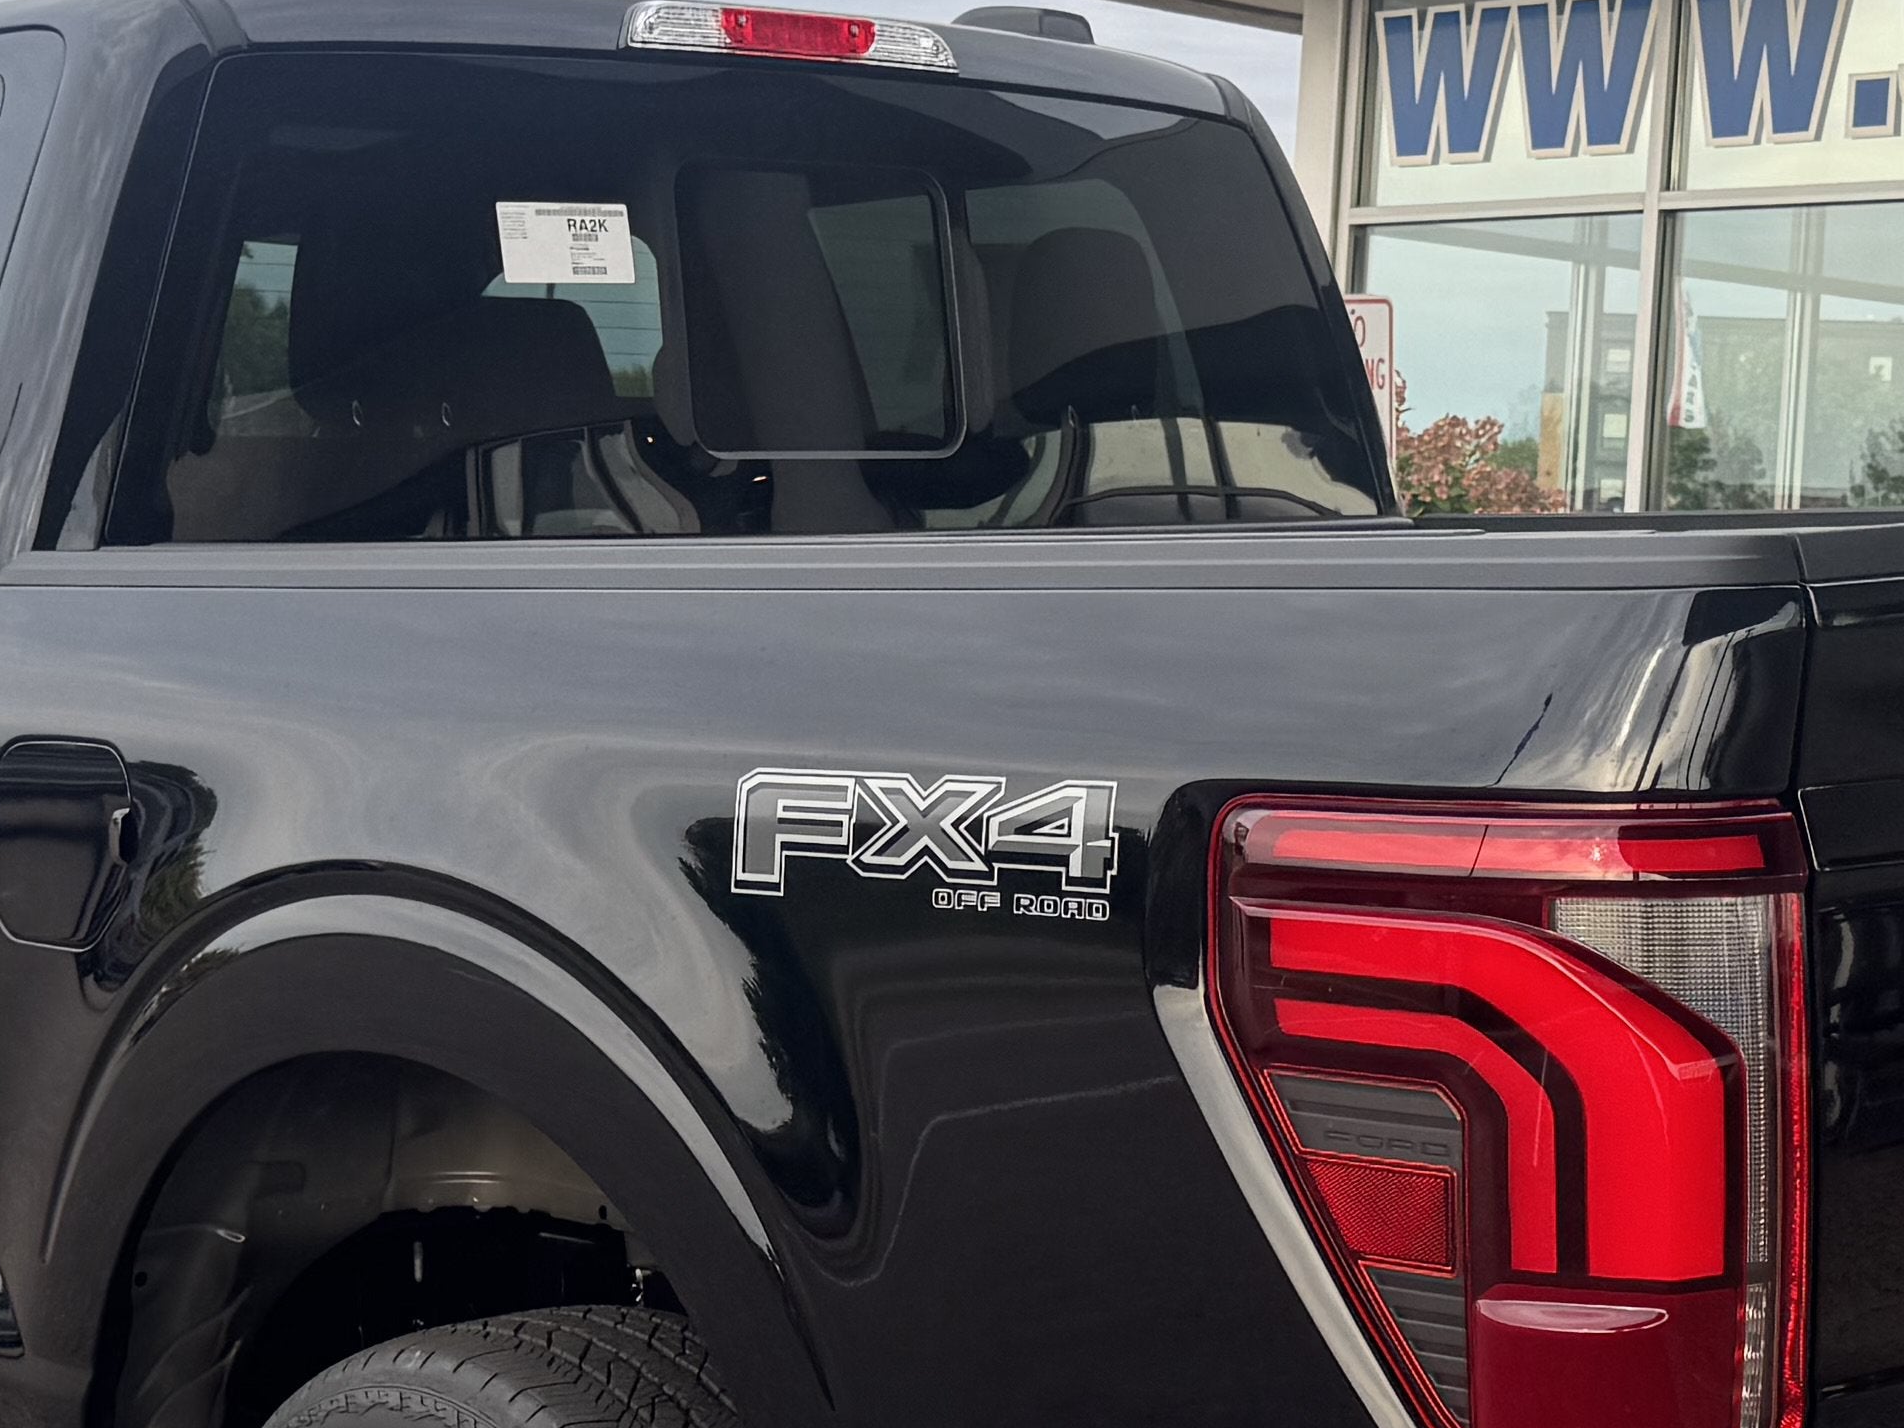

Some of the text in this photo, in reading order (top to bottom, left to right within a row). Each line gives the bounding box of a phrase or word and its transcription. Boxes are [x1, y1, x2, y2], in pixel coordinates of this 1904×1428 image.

[567, 218, 609, 233] RA2K
[731, 767, 1118, 897] FX4
[932, 888, 1110, 921] OFF ROAD
